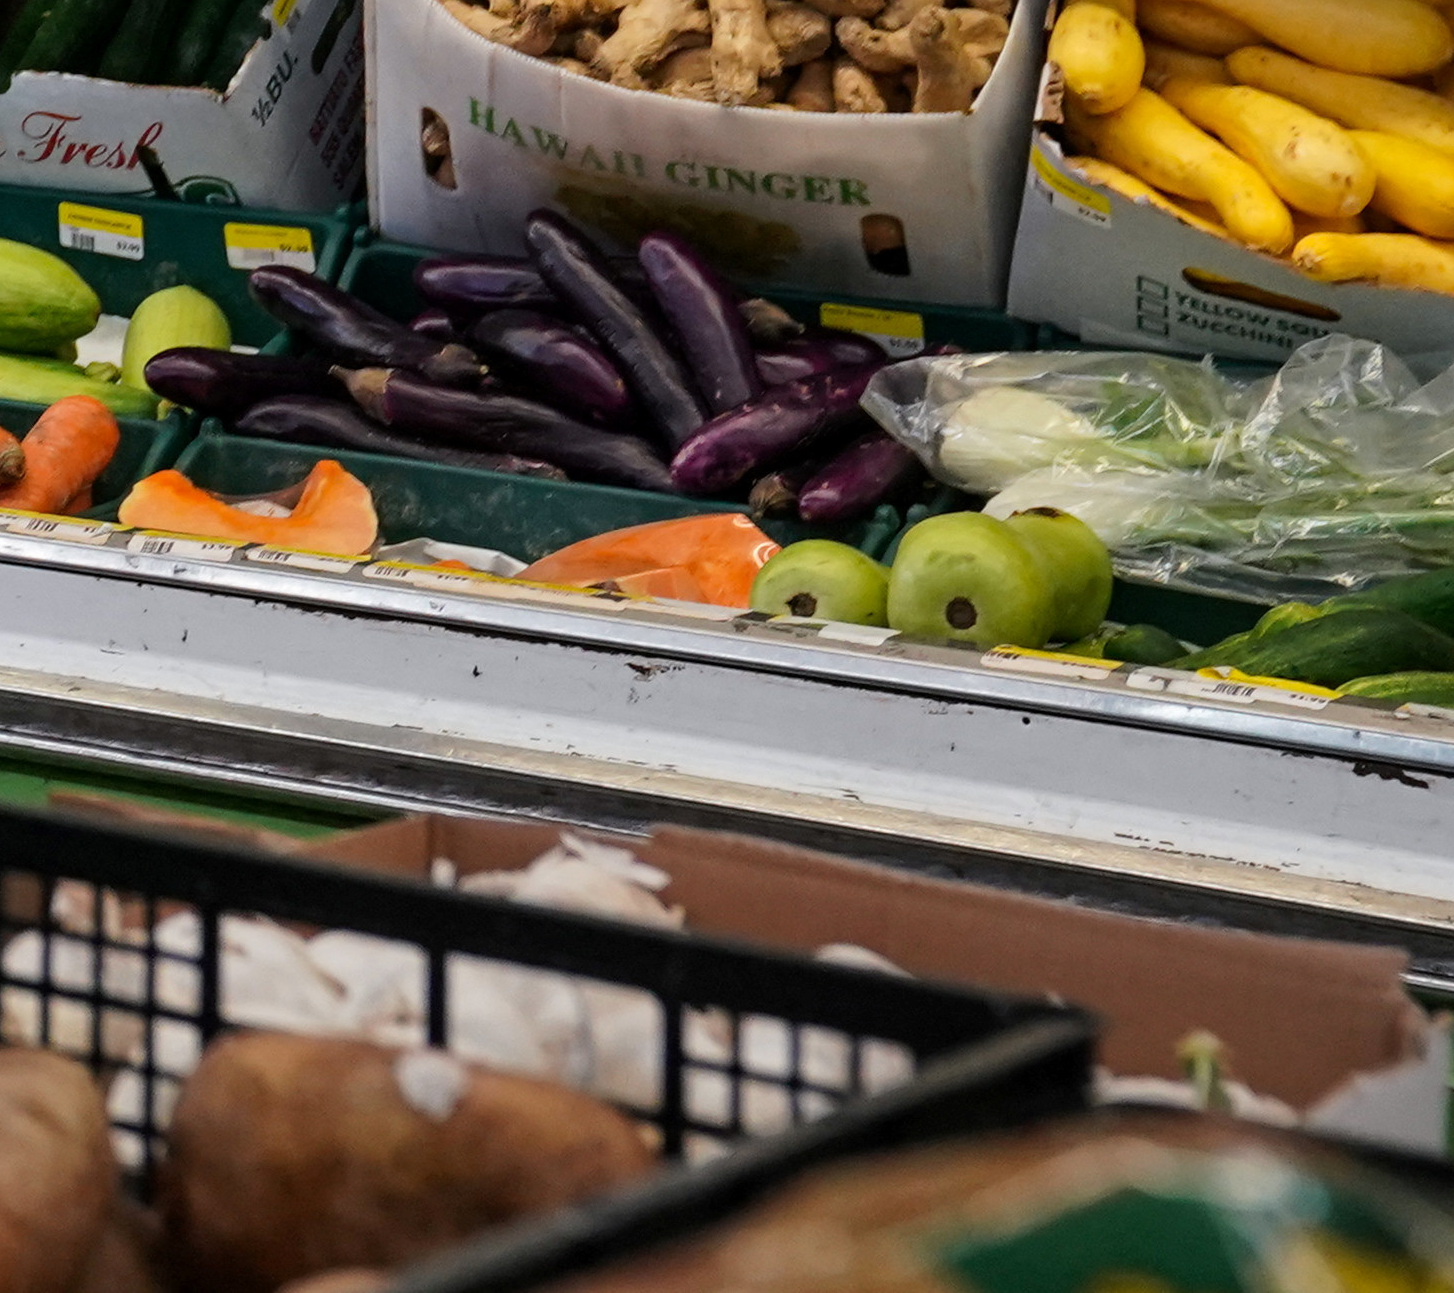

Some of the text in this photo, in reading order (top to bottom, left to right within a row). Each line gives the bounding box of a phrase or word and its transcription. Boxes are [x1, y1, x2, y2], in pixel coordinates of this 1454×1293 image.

[16, 109, 164, 172] Fresh
[468, 96, 872, 208] HAWAII GINGER
[1175, 288, 1270, 327] YELLOW
[1176, 314, 1294, 350] ZUCCHINI
